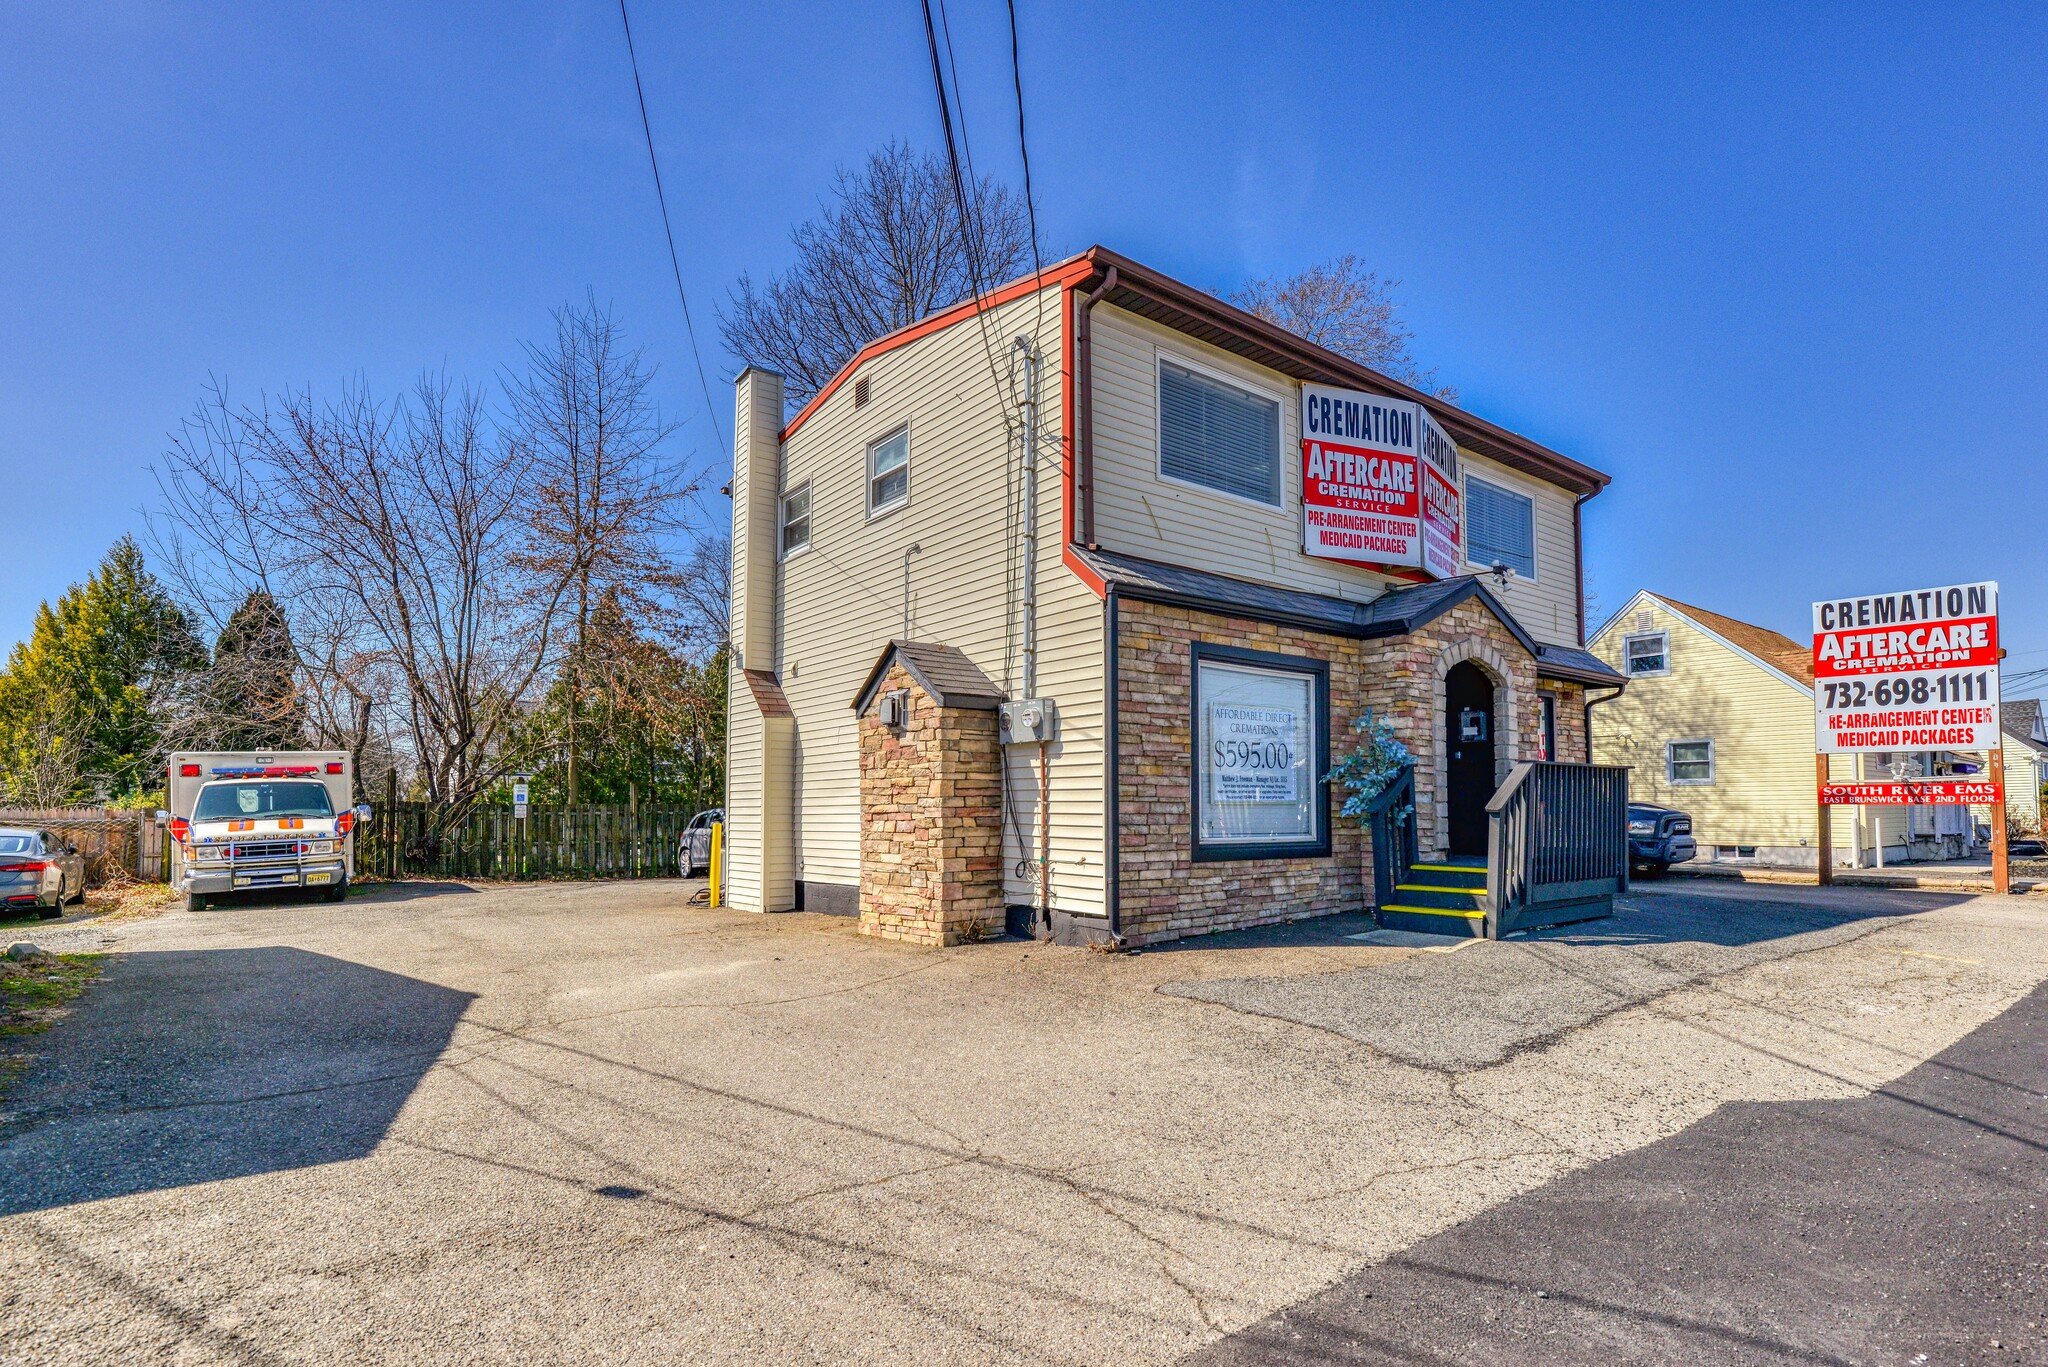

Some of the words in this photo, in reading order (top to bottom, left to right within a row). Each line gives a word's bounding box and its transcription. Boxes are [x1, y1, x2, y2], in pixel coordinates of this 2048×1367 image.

[1308, 394, 1412, 448] CREMATION
[1422, 418, 1457, 483] CREMATION
[1307, 443, 1415, 494] AFTERCARE
[1318, 481, 1405, 506] CREMATION
[1336, 498, 1390, 513] SERVICE
[1424, 464, 1459, 524] AFTERCARE
[1308, 510, 1386, 534] PRE-ARRANGEMENT
[1387, 521, 1417, 538] CENTER
[1320, 530, 1363, 549] MEDICAID
[1364, 536, 1407, 555] PACKAGES
[1820, 585, 1987, 631] CREMATION
[1818, 623, 1990, 662] AFTERCARE
[1832, 649, 1970, 670] CREMATION
[1859, 662, 1943, 674] SERVICE
[1823, 671, 1988, 709] 732-698-1111
[1215, 708, 1263, 721] AFFORDABLE
[1265, 713, 1291, 723] DIRECT
[1941, 708, 1993, 726] CENTER
[1230, 723, 1278, 735] CREMATIONS
[1837, 730, 1899, 747] MEDICAID
[1902, 728, 1975, 746] PACKAGES
[1823, 785, 1883, 796] SOUTH
[1891, 785, 1945, 795] RIVER
[1954, 784, 1995, 795] EMS
[1823, 795, 1845, 804] EAST
[1849, 795, 1903, 803] BRUNSWICK
[1907, 795, 1931, 803] BASE
[1934, 795, 1956, 803] 2ND
[1960, 794, 1996, 803] FLOOR
